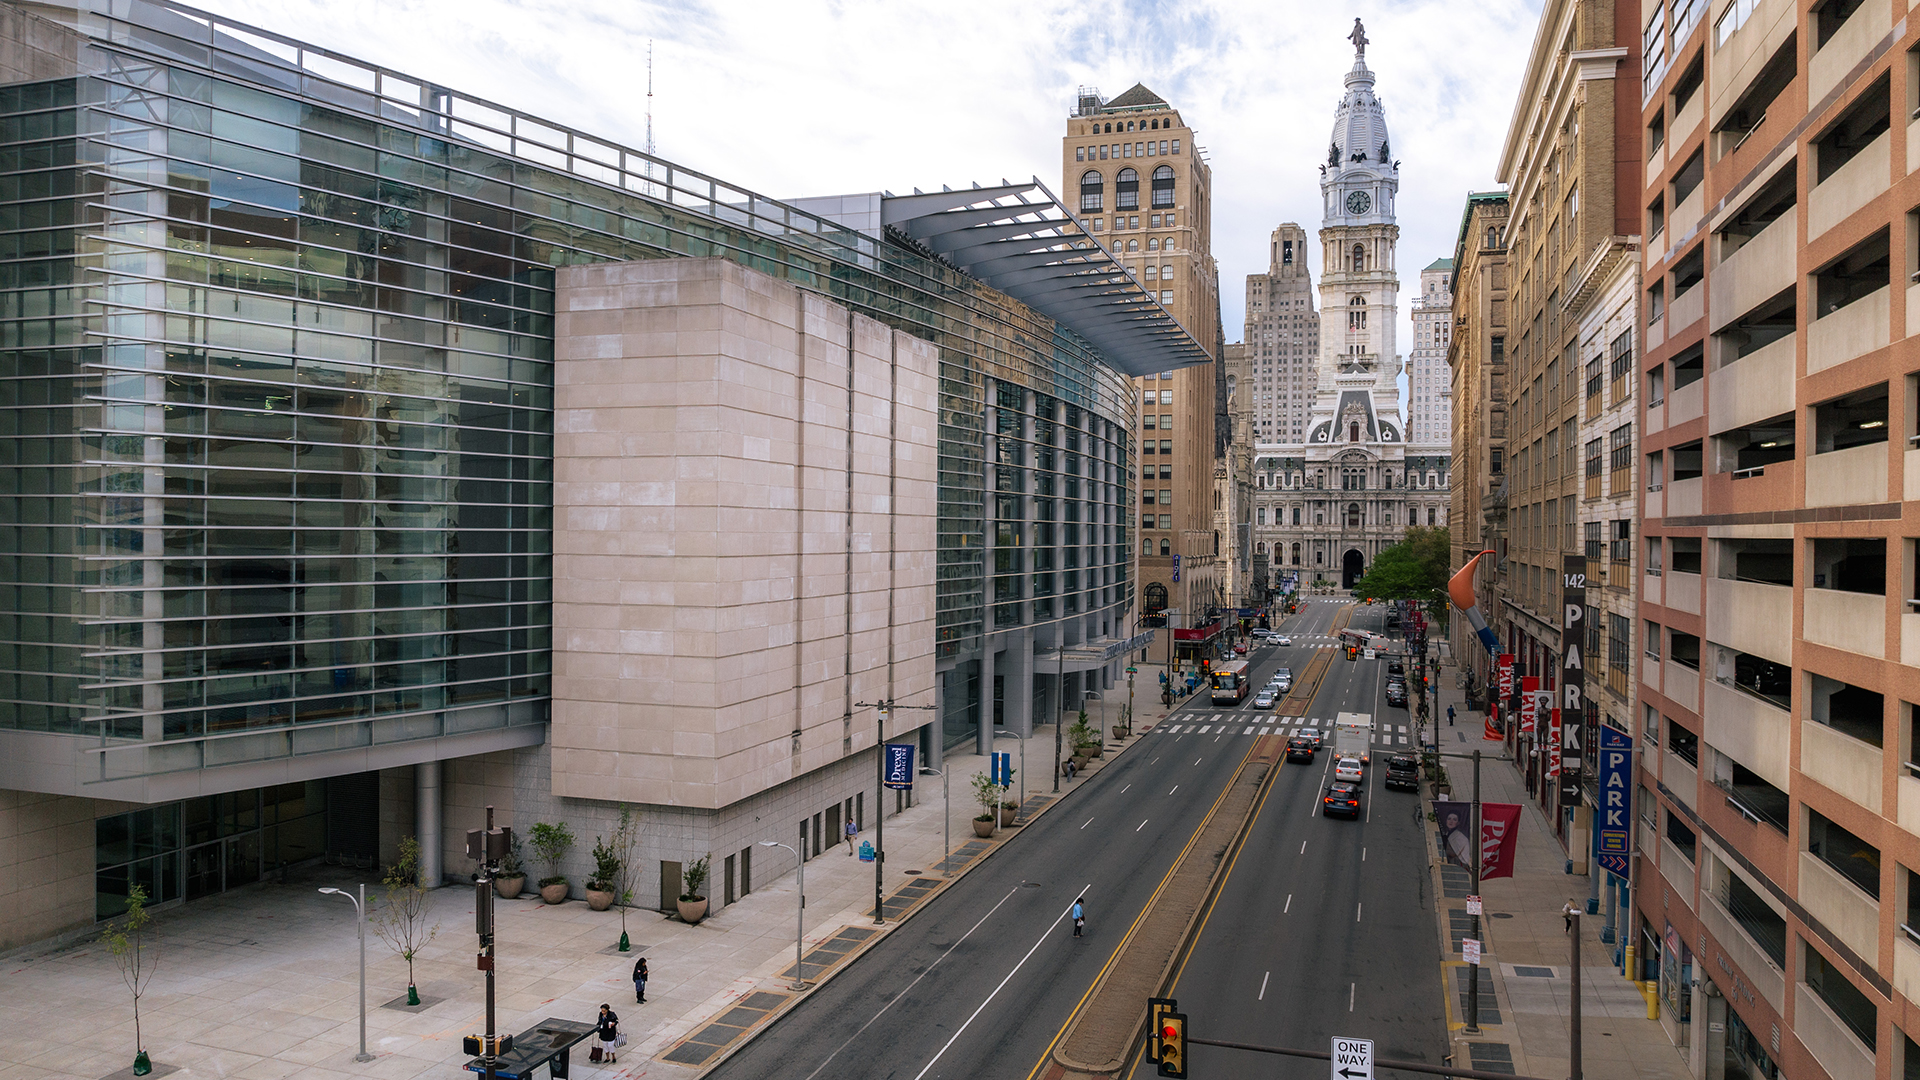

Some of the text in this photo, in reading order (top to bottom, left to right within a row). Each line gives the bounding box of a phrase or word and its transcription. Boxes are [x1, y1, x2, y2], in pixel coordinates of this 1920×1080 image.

[1563, 573, 1586, 589] 142
[1499, 666, 1511, 698] PAFA
[1563, 603, 1583, 750] PARK
[1521, 690, 1535, 732] PAFA
[891, 747, 902, 781] Drexel
[1607, 752, 1625, 826] PARK
[1482, 818, 1505, 879] PAFA
[1337, 1054, 1367, 1066] WAY
[1338, 1041, 1367, 1054] ONE
